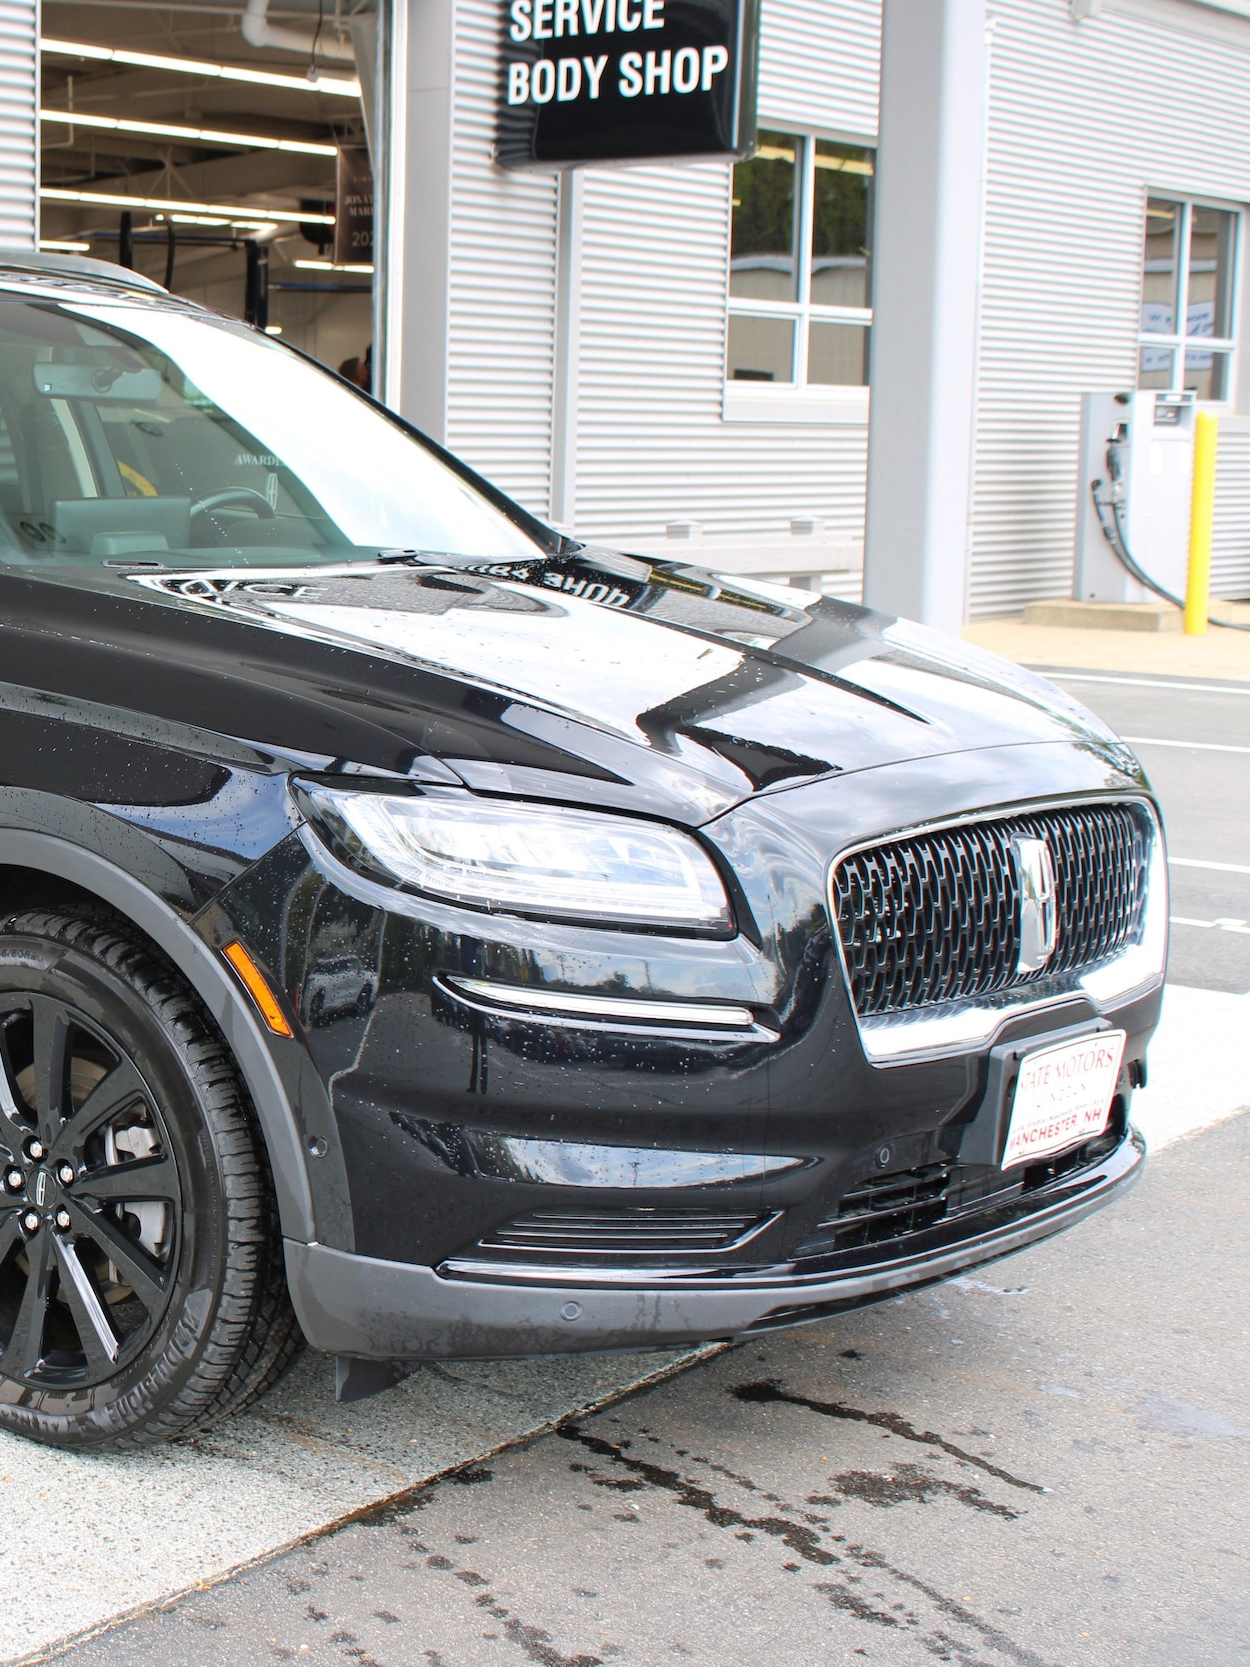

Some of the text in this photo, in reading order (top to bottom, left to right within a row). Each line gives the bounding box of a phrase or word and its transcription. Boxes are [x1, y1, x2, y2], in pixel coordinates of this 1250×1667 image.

[510, 0, 665, 42] SERVICE
[508, 45, 729, 106] BODY SHOP
[1056, 1047, 1115, 1079] MOTORS
[1084, 1108, 1102, 1123] NH
